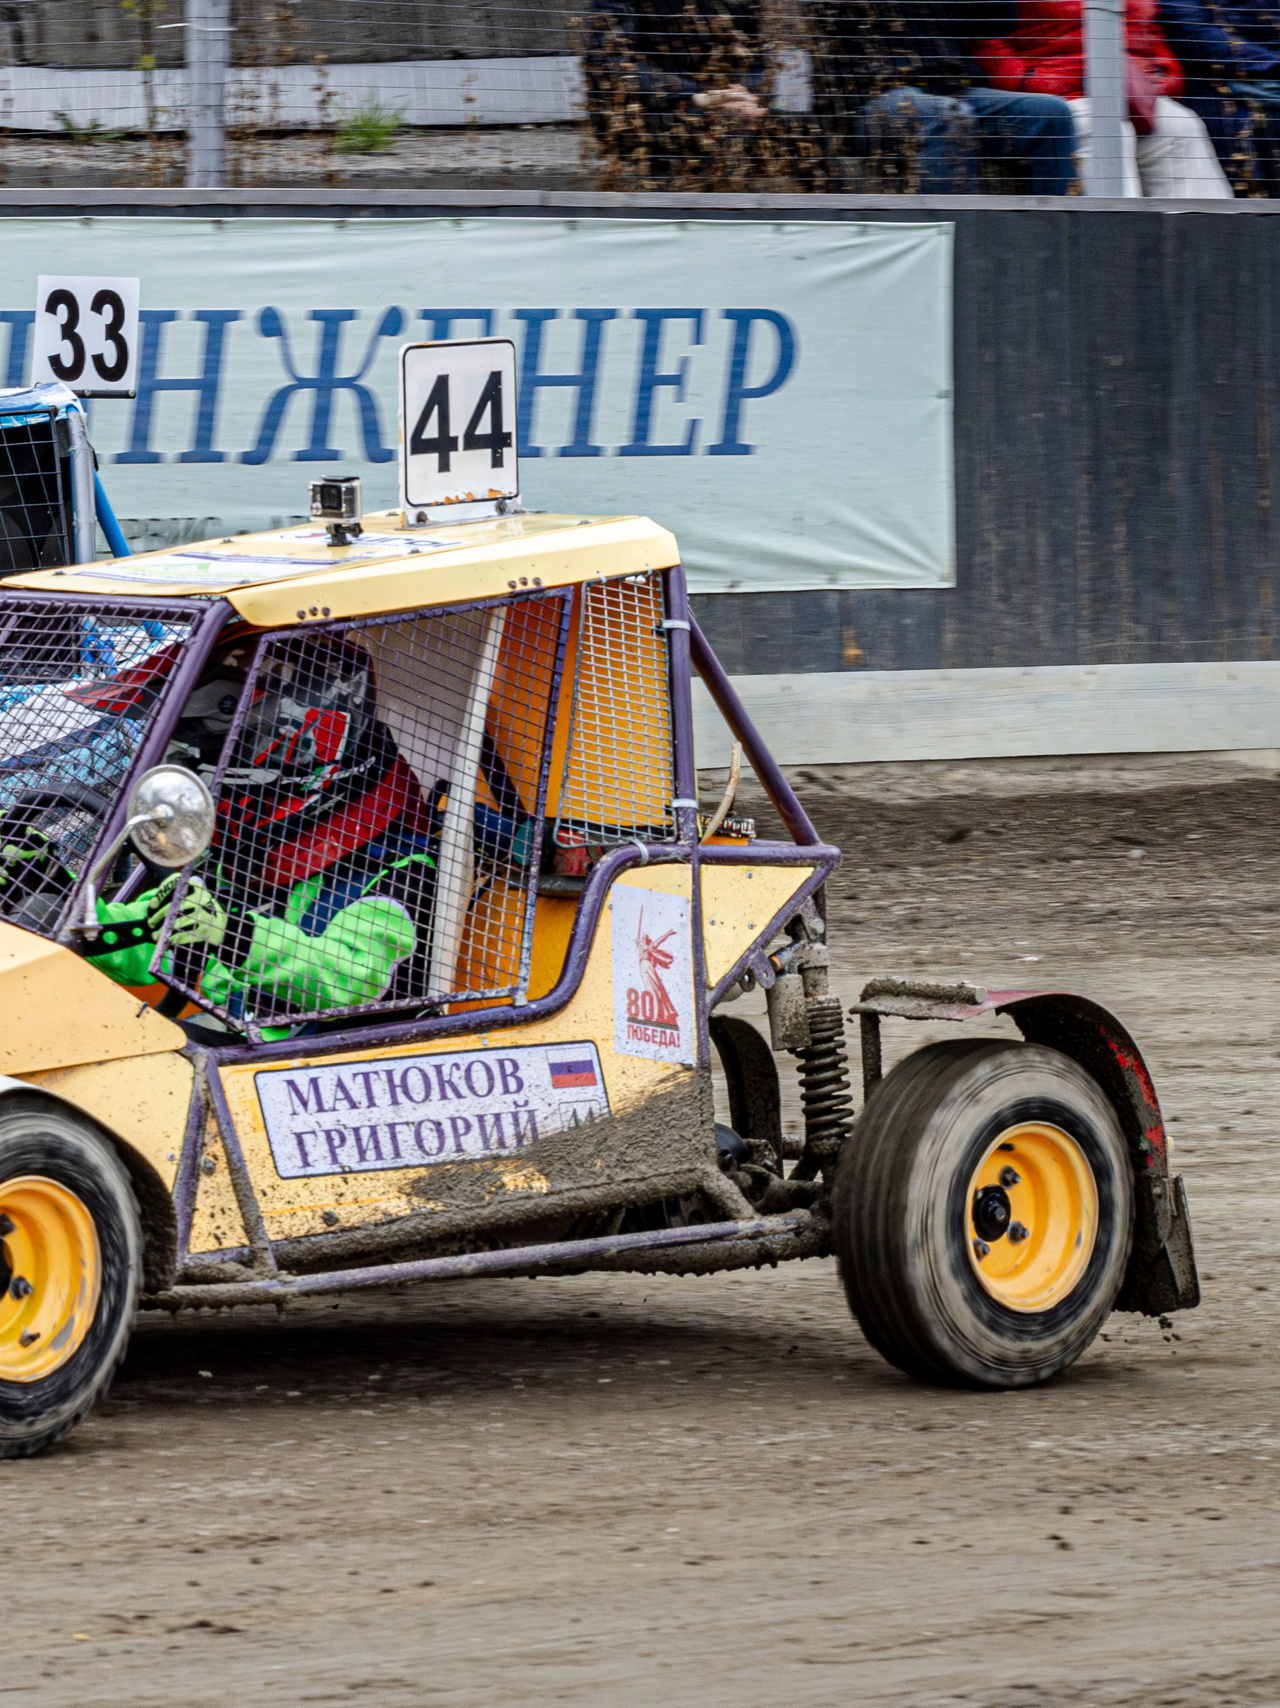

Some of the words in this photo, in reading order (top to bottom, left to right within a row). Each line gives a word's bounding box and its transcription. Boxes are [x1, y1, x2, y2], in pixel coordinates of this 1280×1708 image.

[45, 288, 129, 382] 33
[410, 370, 513, 473] 44
[626, 987, 655, 1022] 80
[627, 1024, 680, 1048] ПОБЕДА!
[284, 1057, 524, 1116] МАТЮКОВ
[294, 1101, 541, 1169] ГРИГОРИЙ
